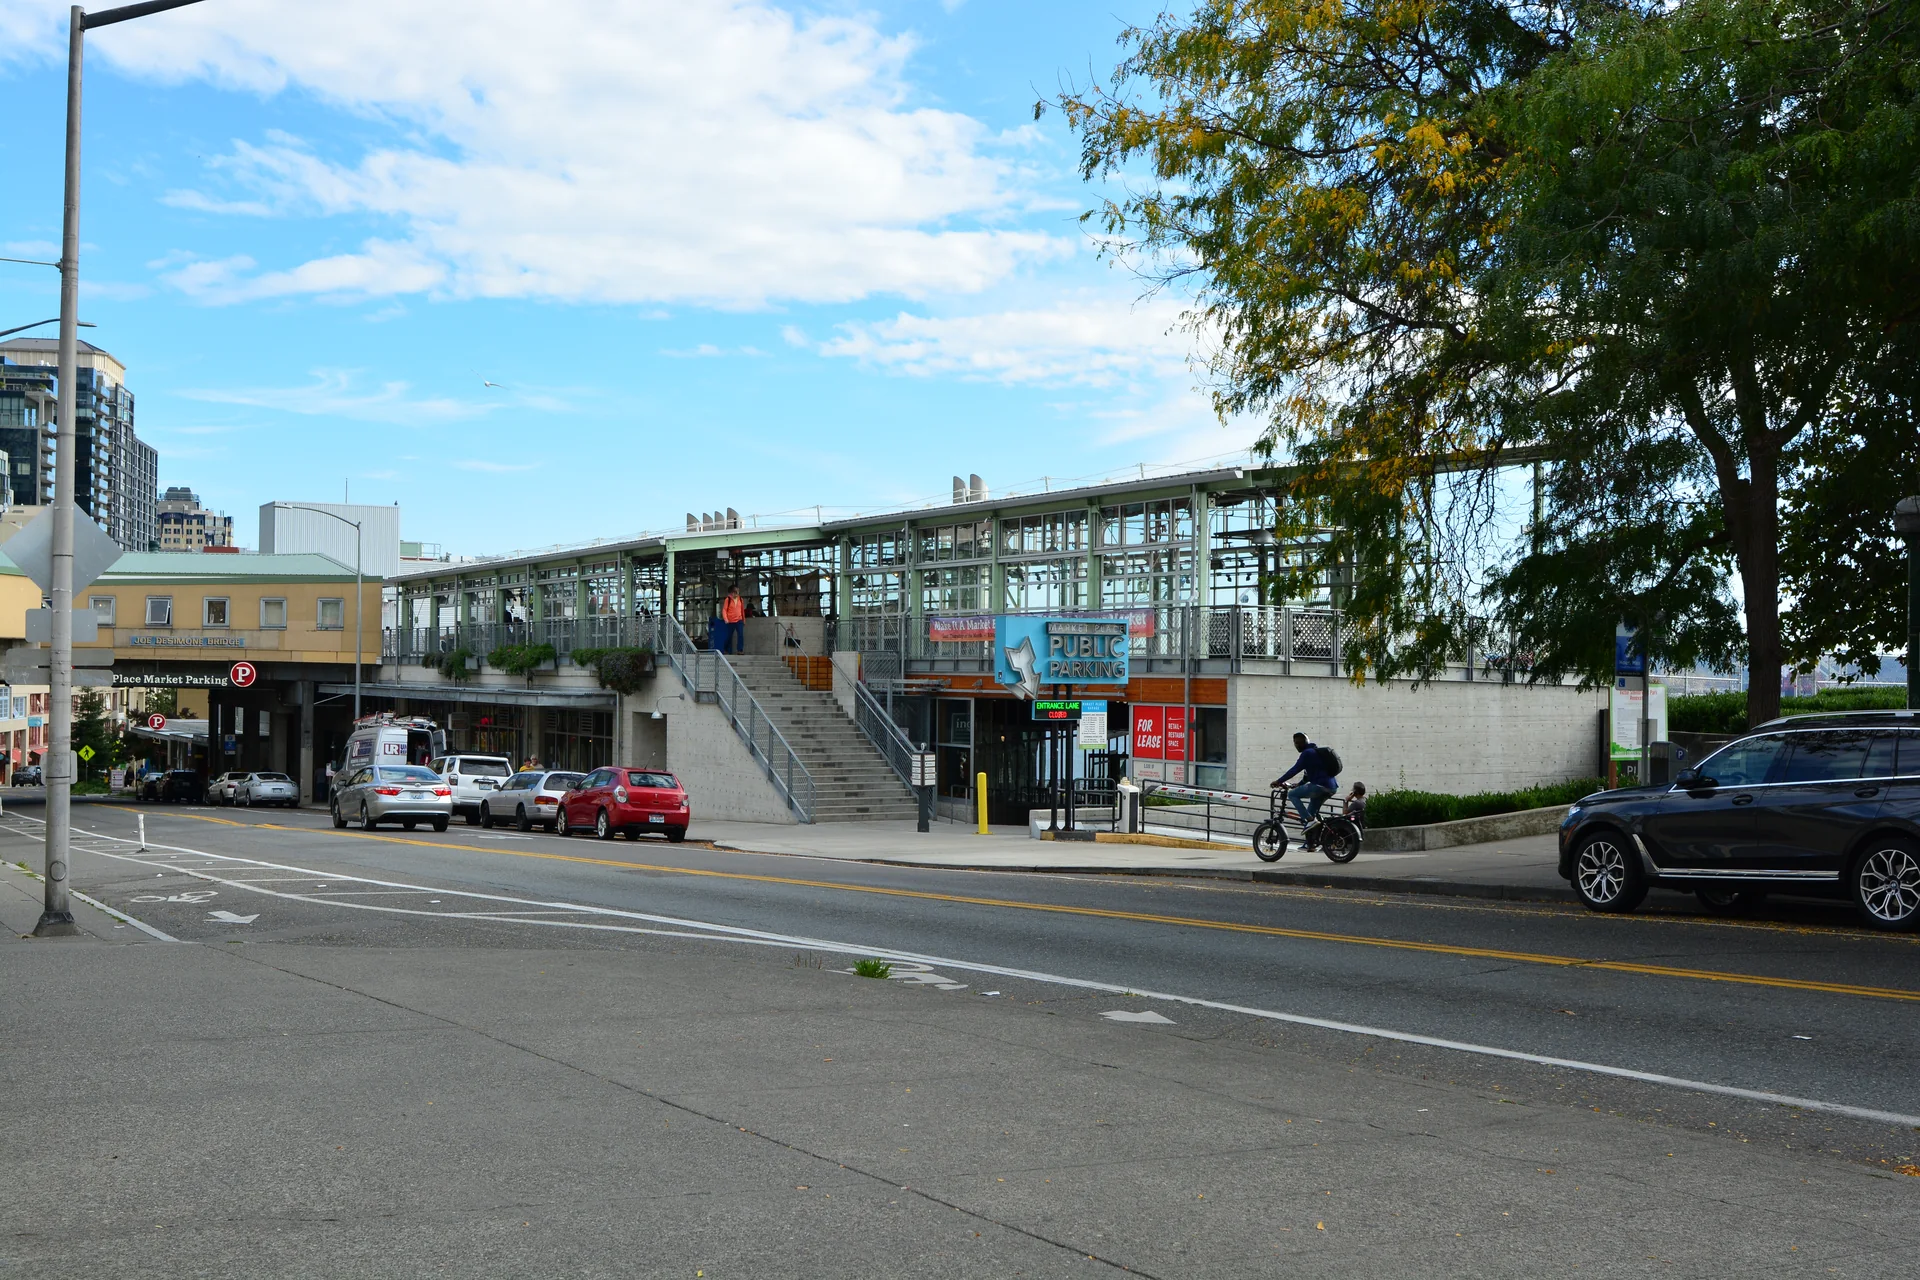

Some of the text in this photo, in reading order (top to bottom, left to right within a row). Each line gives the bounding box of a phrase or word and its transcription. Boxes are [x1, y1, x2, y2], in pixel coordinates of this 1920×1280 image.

[934, 620, 951, 631] Make
[960, 620, 965, 630] A
[966, 619, 991, 630] Market
[1048, 624, 1088, 633] MARKET
[1094, 624, 1125, 634] PLACE
[134, 637, 240, 646] JOE DESIMONE BRIDGE
[1050, 635, 1125, 658] PUBLIC
[236, 666, 251, 683] P
[1050, 660, 1125, 678] PARKING
[112, 674, 228, 687] Place Market Parking
[1036, 702, 1080, 710] ENTRANCE LANE
[153, 717, 163, 728] P
[1137, 719, 1153, 732] FOR
[1137, 735, 1162, 748] LEASE
[385, 744, 399, 755] UR
[1677, 750, 1683, 758] P
